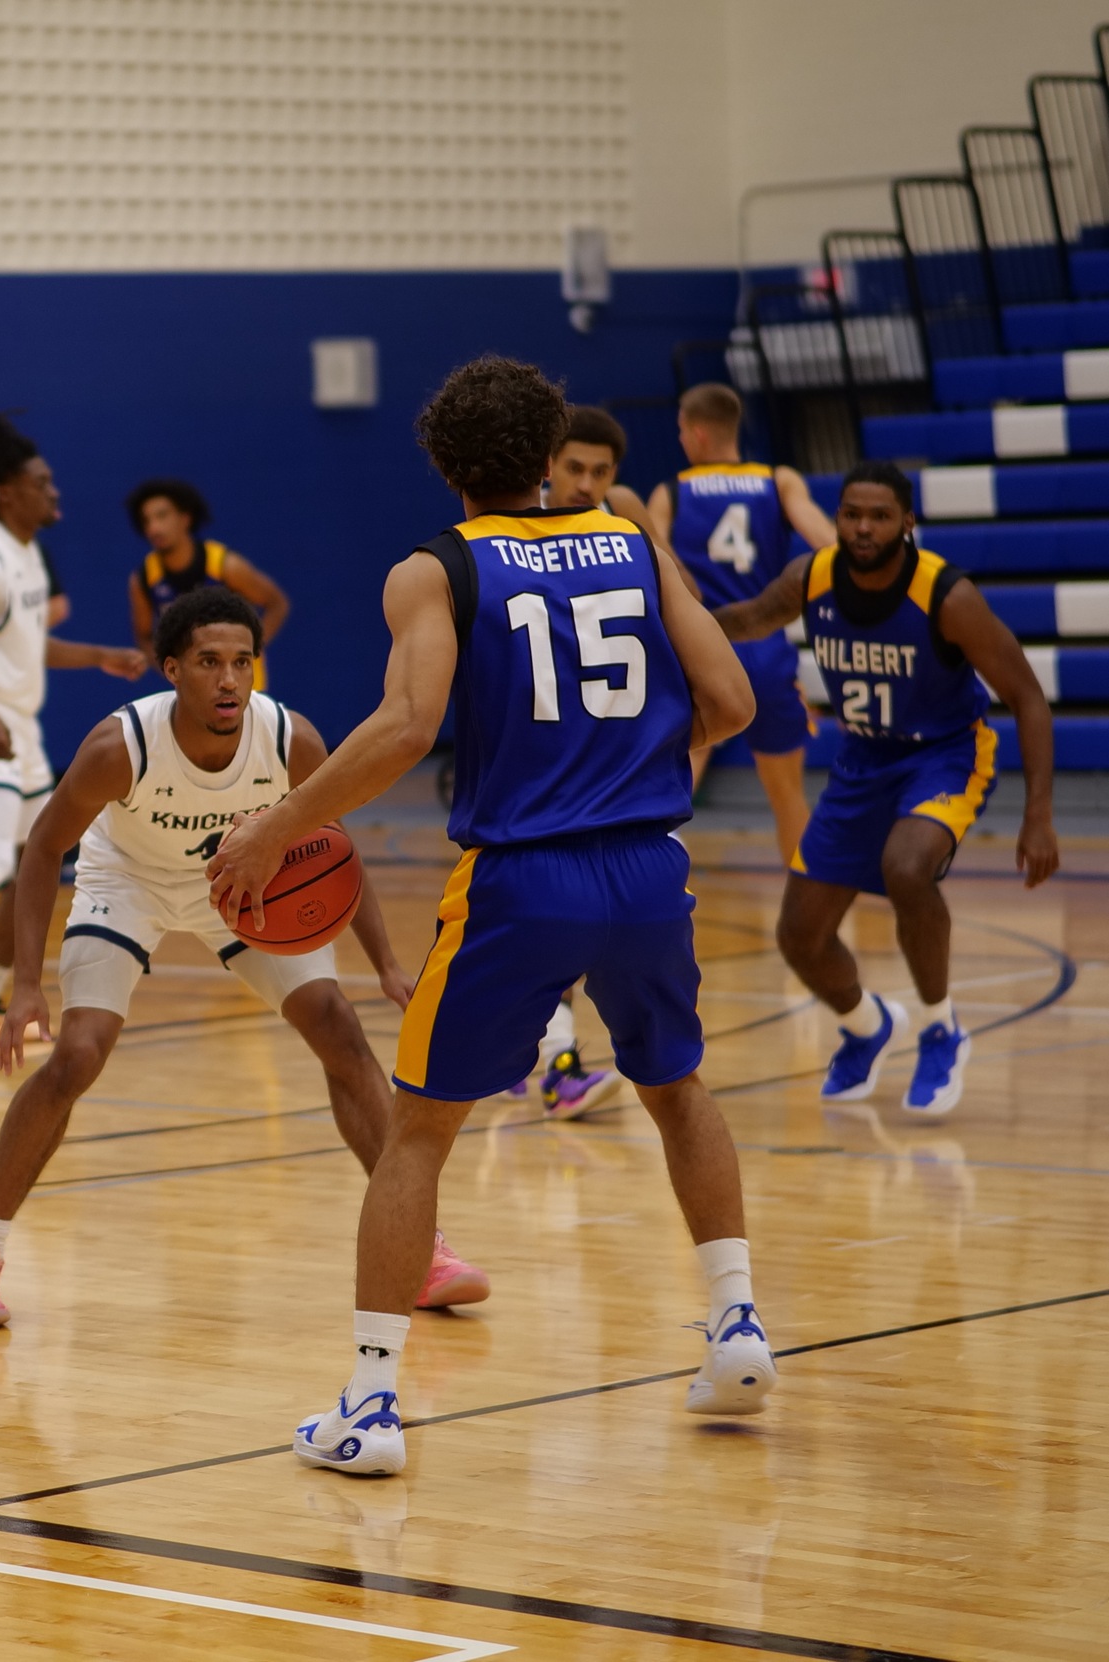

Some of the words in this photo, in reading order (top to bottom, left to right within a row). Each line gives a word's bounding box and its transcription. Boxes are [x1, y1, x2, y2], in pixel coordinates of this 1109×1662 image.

[690, 474, 766, 496] TOGETHER
[490, 535, 633, 573] TOGETHER
[707, 502, 757, 575] 4
[506, 588, 647, 722] 15
[814, 634, 917, 678] HILBERT
[842, 679, 891, 728] 21
